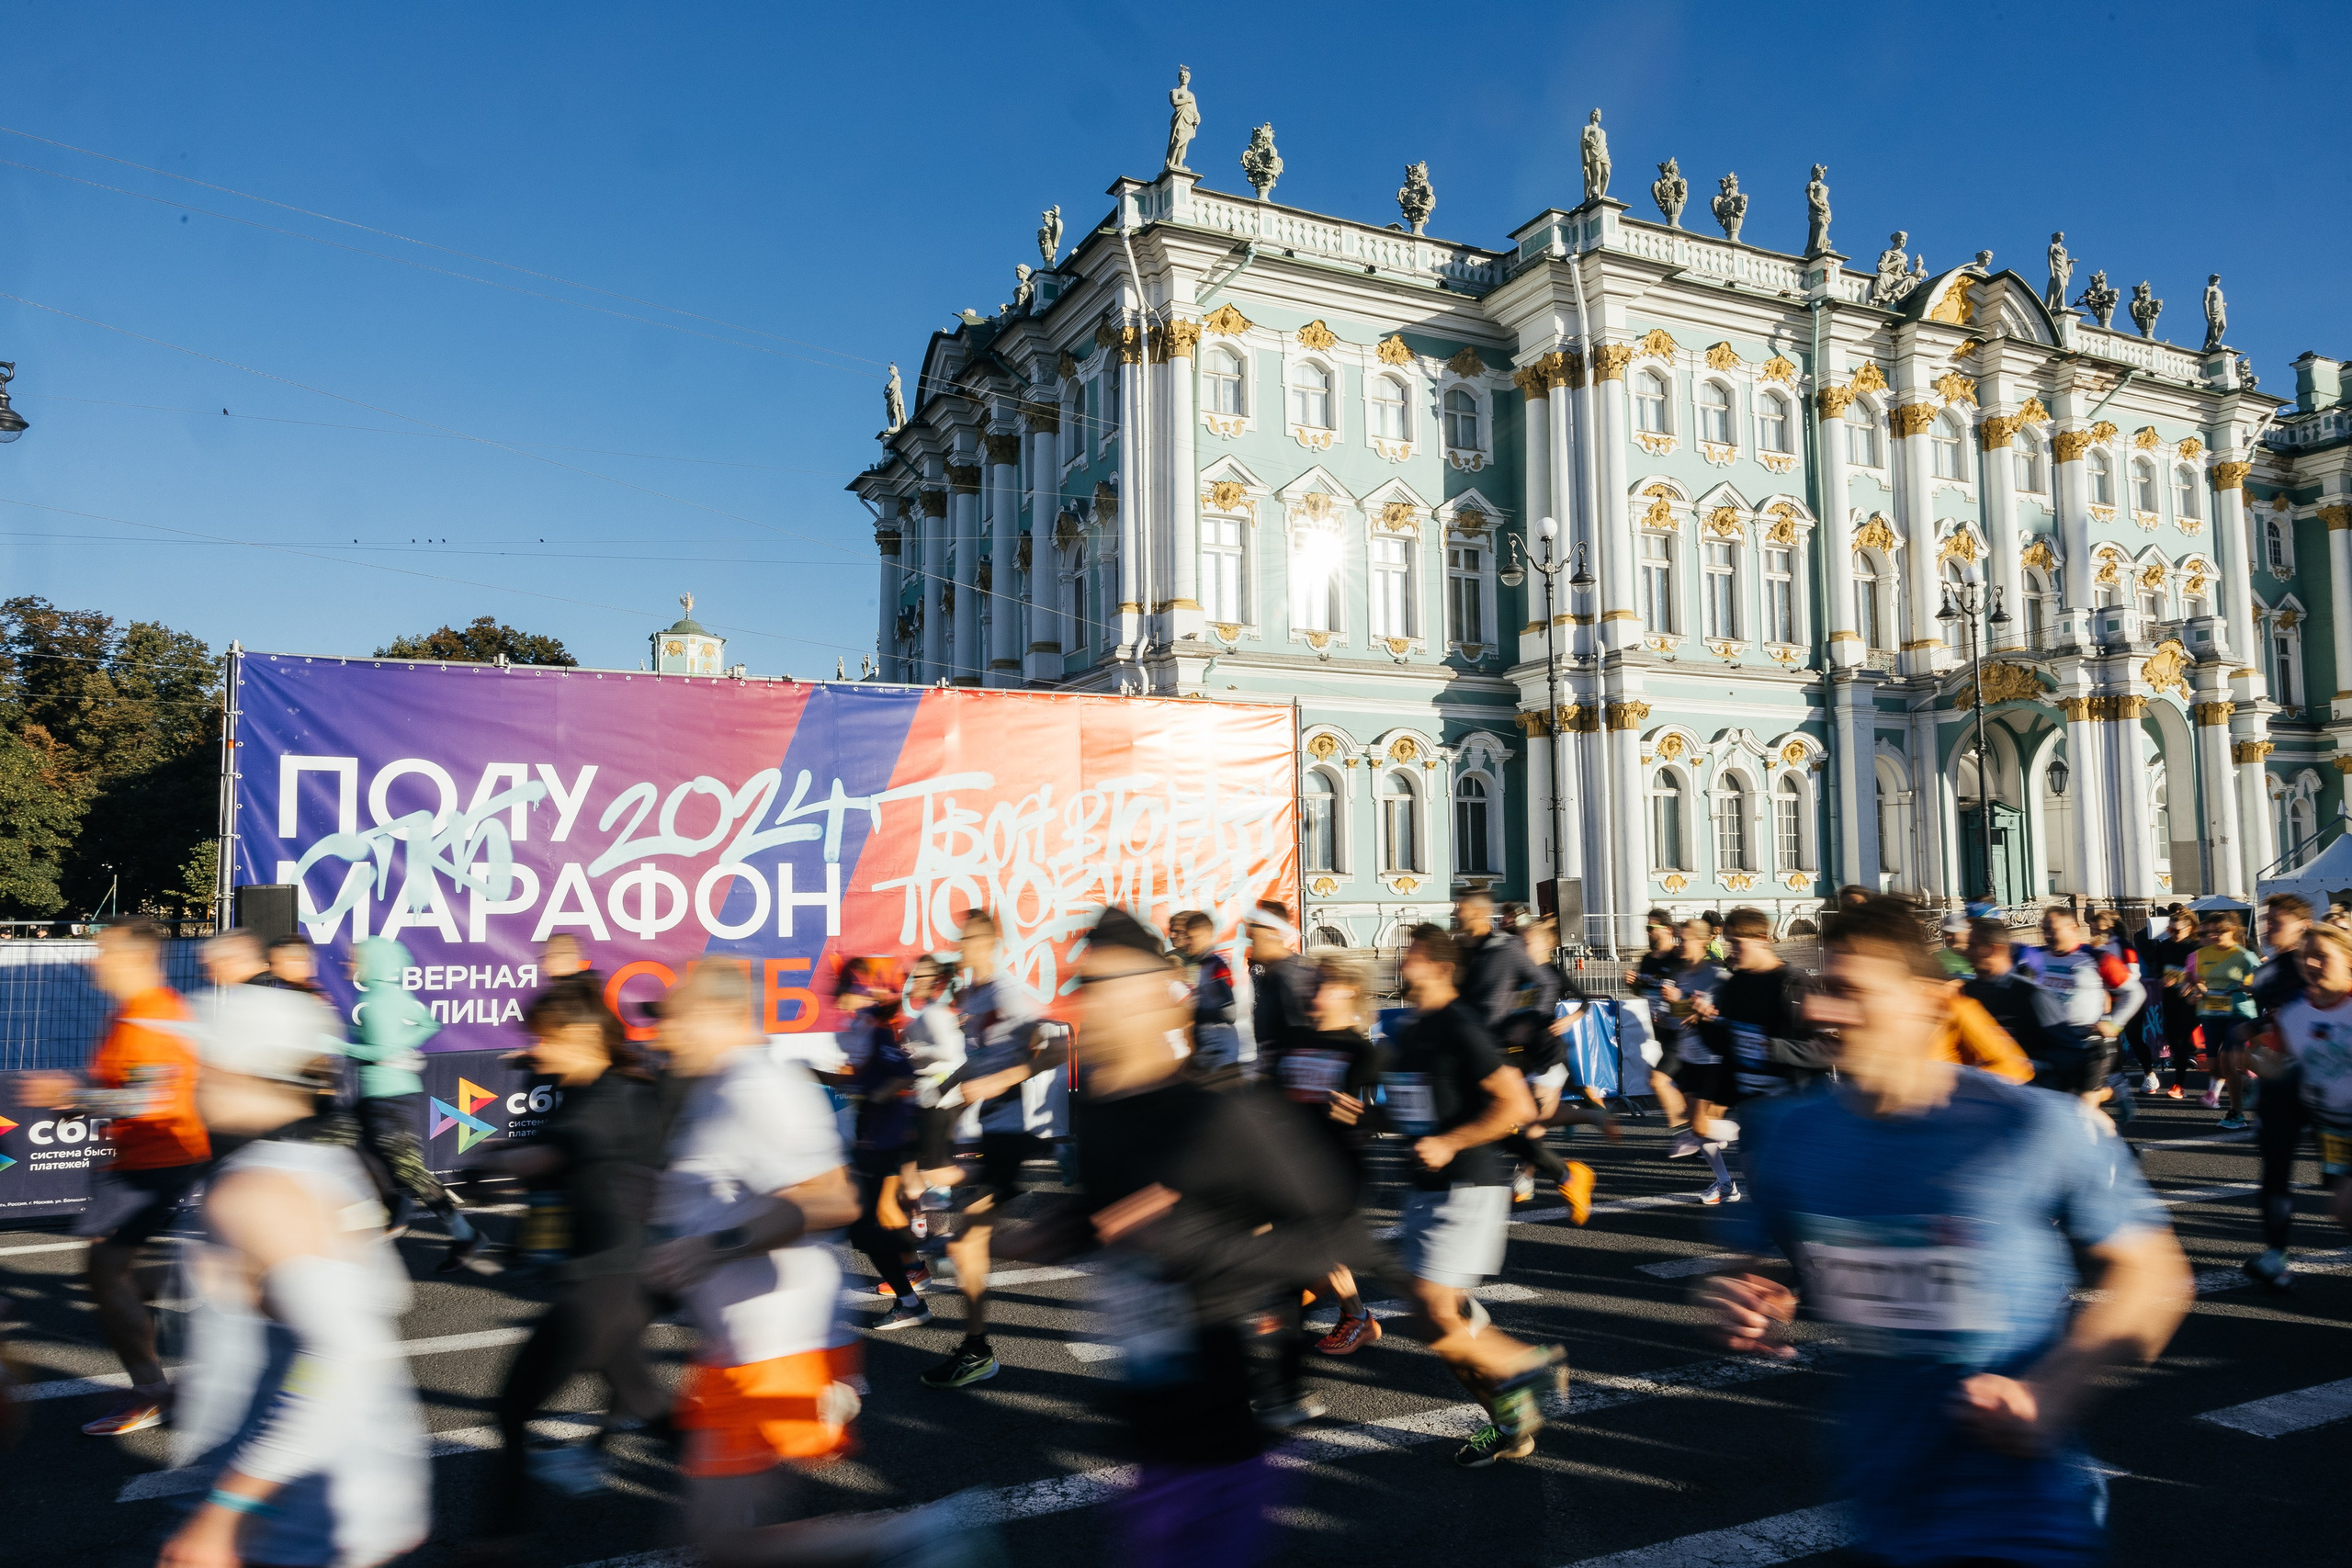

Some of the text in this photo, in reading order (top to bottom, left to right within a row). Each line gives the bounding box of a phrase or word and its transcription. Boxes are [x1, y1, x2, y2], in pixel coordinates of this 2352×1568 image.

[278, 755, 599, 842] ПОЛУ
[587, 768, 872, 878] 2024
[277, 860, 842, 944] МАРАФОН
[353, 964, 538, 992] ВЕРНАЯ
[508, 1129, 538, 1138] плате
[29, 1158, 90, 1172] платежей
[30, 1148, 82, 1160] система
